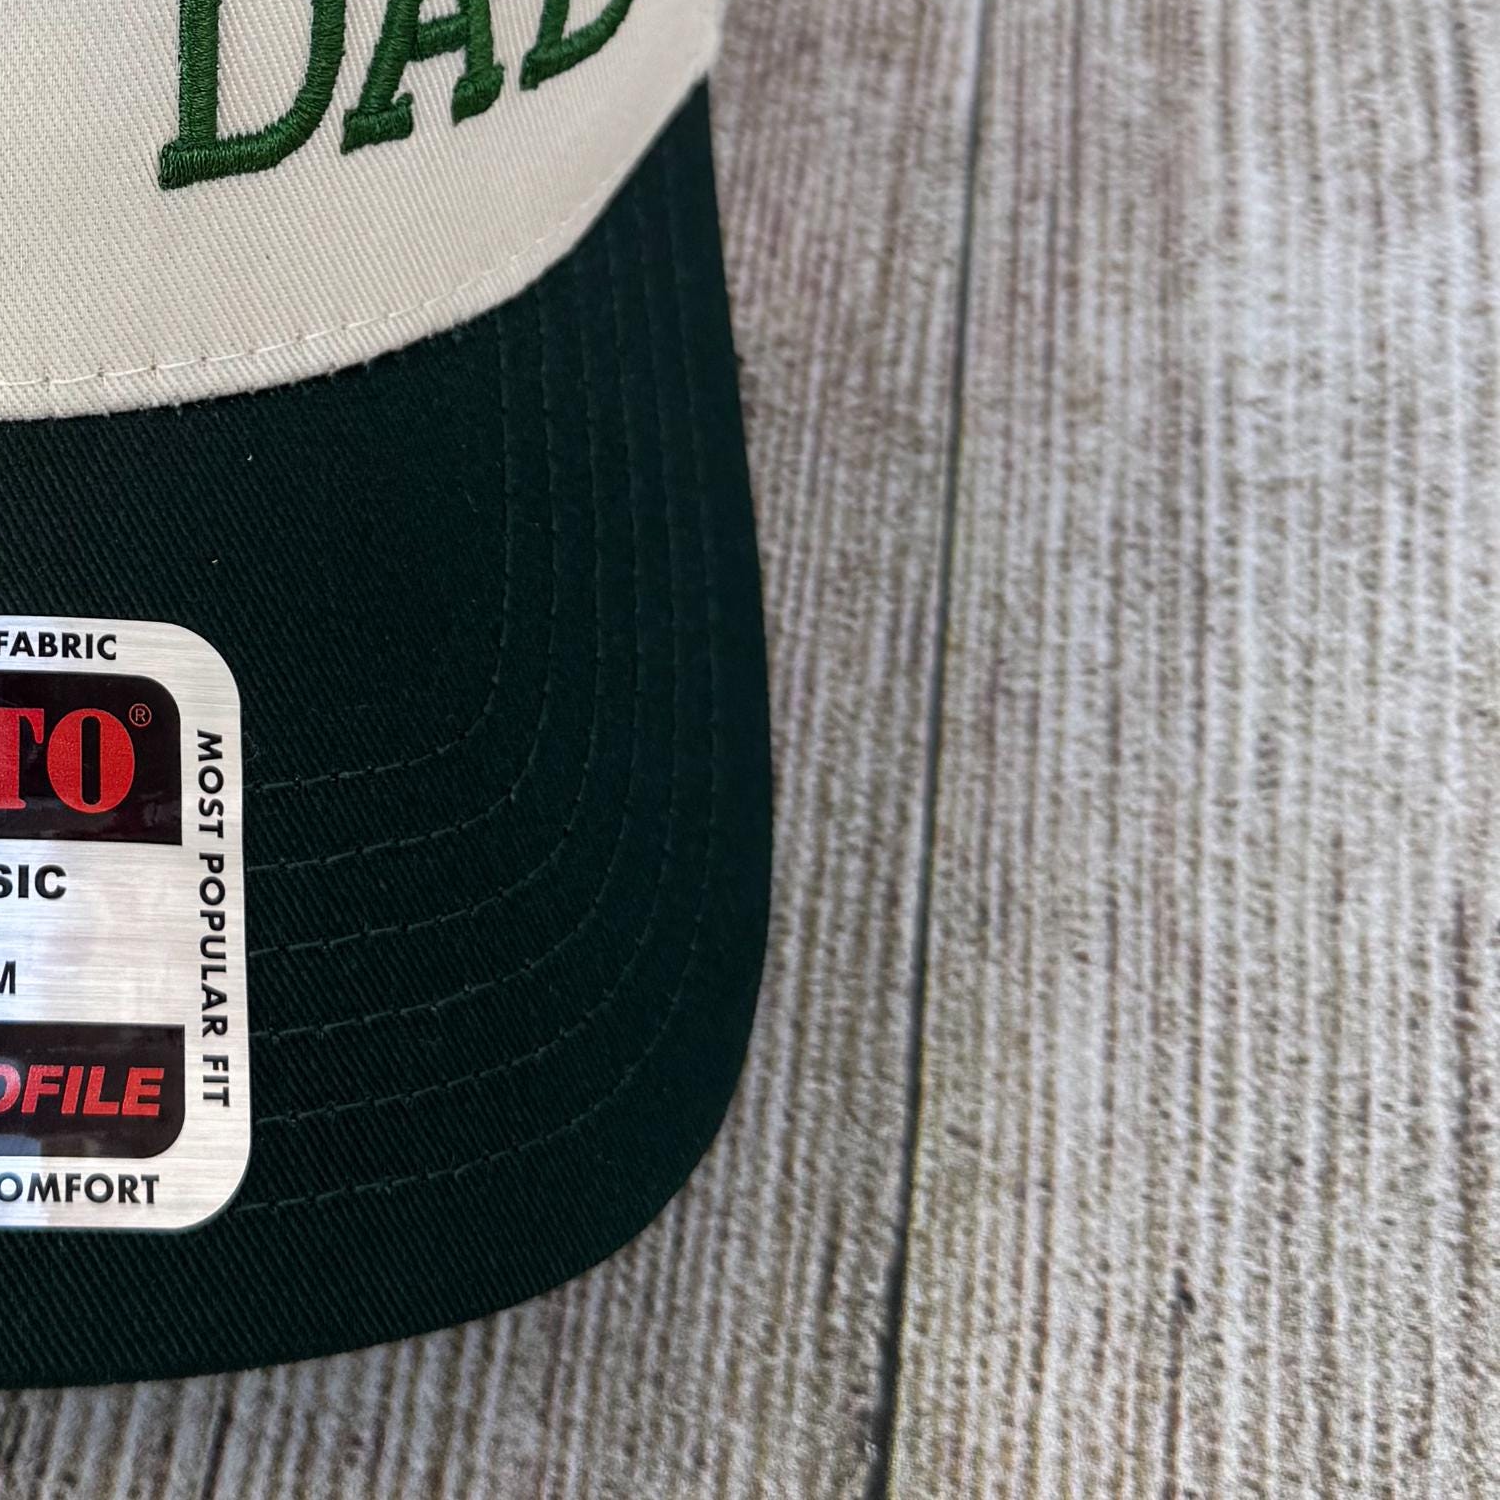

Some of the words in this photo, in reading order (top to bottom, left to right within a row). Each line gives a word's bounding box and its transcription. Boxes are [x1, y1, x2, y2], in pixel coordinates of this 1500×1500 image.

[197, 728, 224, 839] MOST
[199, 853, 229, 1038] POPULAR
[202, 1053, 231, 1107] FIT
